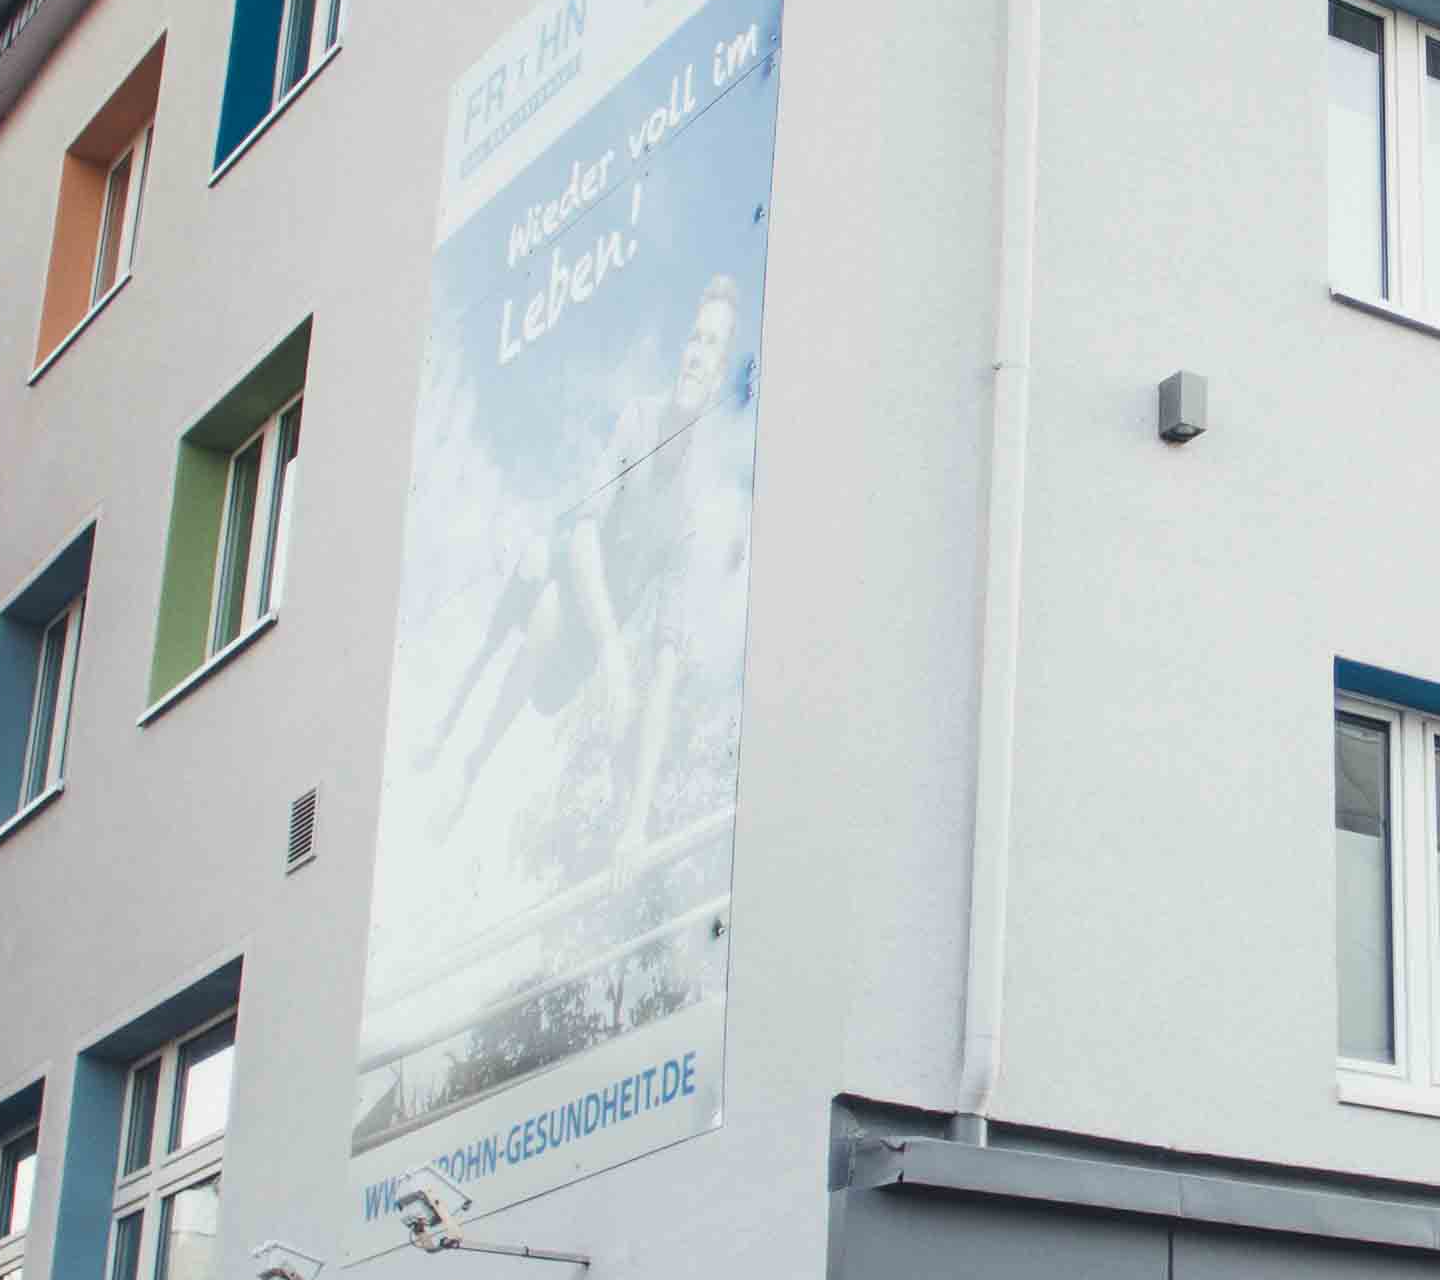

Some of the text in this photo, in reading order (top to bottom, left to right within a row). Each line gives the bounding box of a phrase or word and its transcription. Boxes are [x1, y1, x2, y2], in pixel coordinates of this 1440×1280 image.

[507, 148, 615, 268] Wieder
[629, 62, 696, 160] voll
[713, 22, 760, 88] im
[498, 181, 641, 366] Leben!
[364, 1050, 696, 1221] WWROHN-GESUNDHEIT.DE
